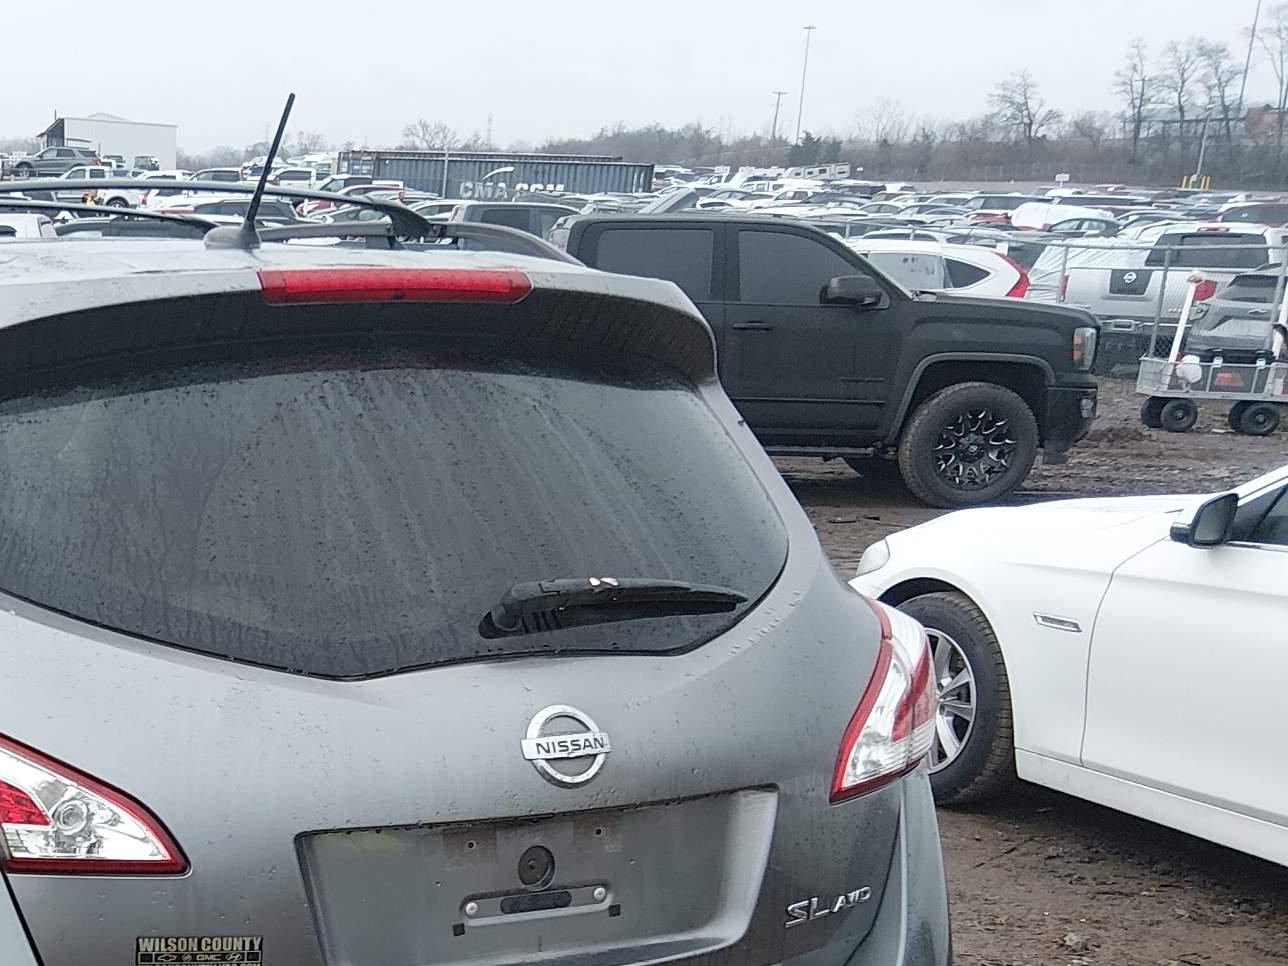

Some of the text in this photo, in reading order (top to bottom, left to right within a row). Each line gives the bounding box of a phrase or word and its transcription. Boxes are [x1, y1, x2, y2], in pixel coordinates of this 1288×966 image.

[460, 182, 508, 199] CMA
[535, 736, 605, 755] NISSAN
[785, 886, 871, 928] SL AWD
[138, 936, 262, 952] WILSON COUNTY
[196, 953, 222, 961] GMC
